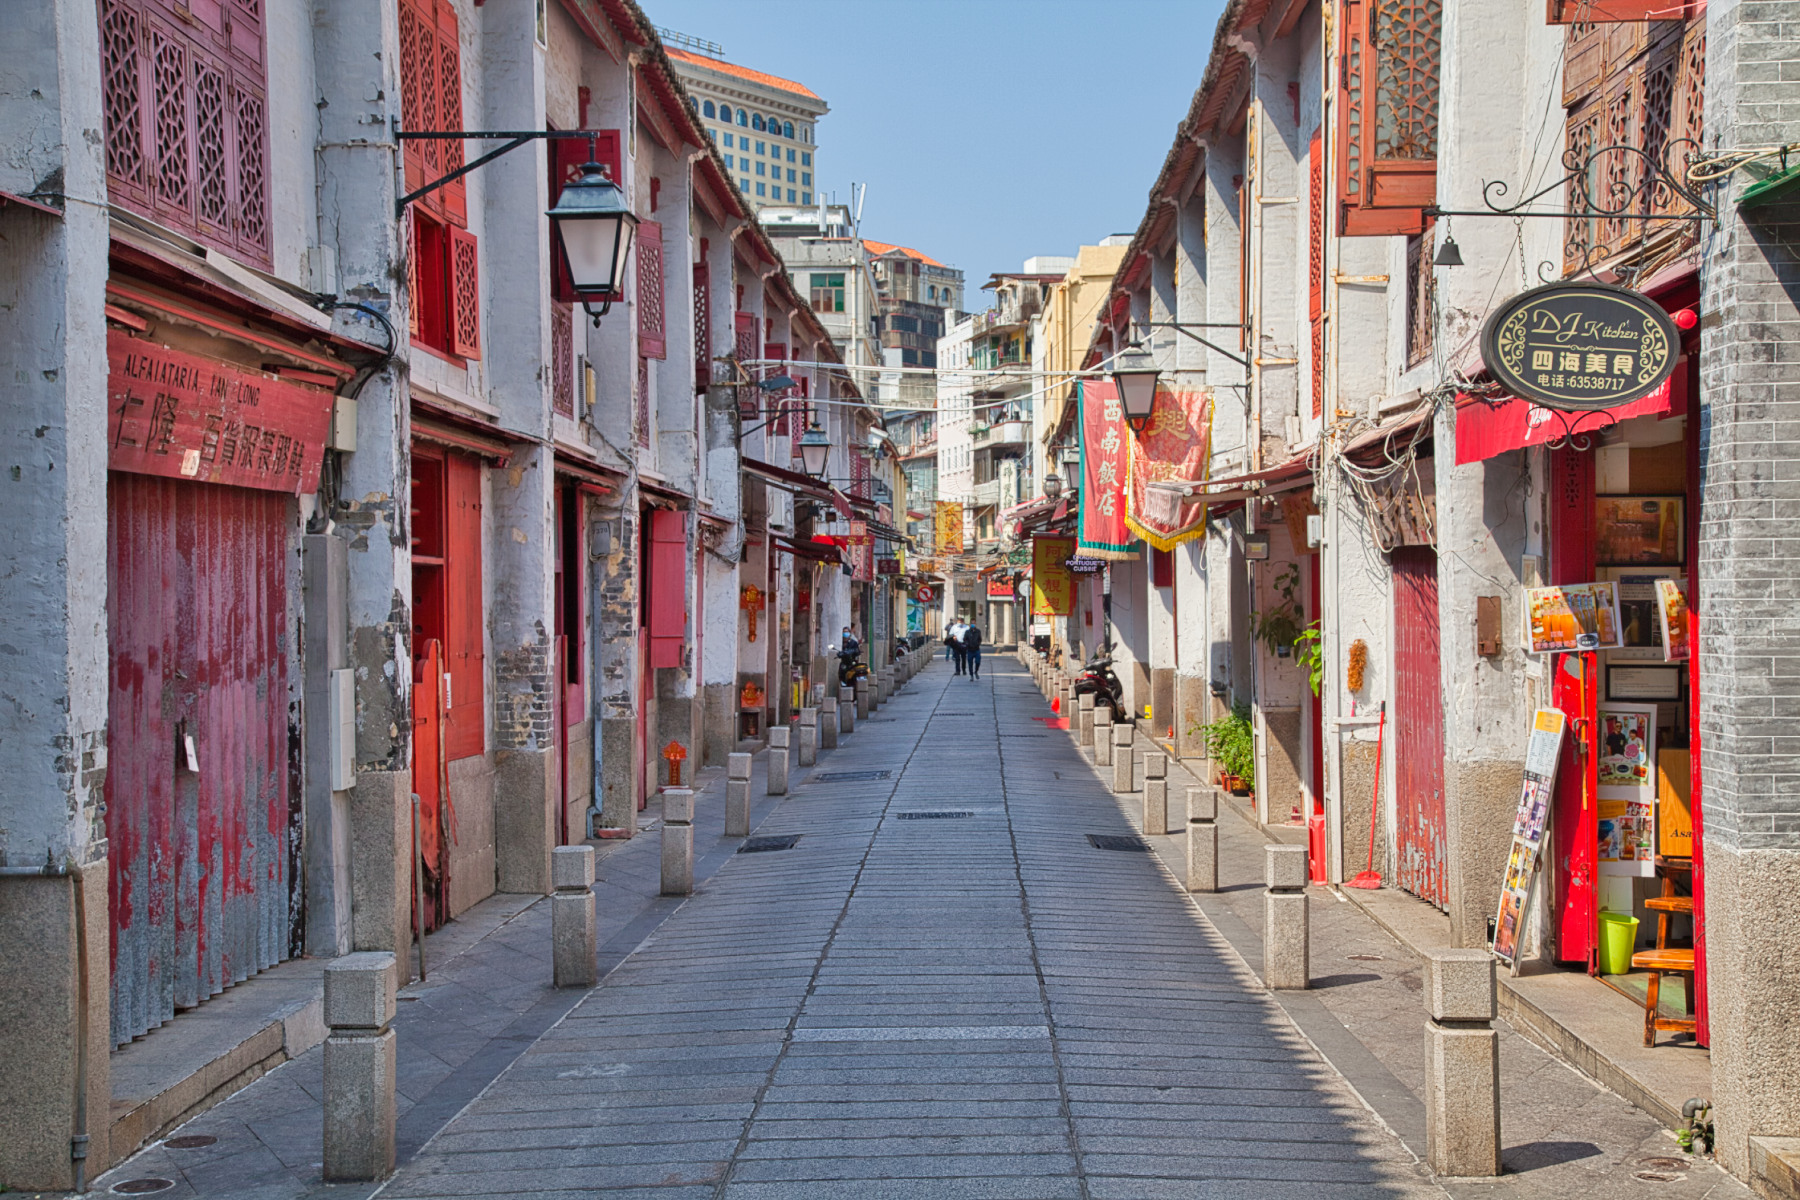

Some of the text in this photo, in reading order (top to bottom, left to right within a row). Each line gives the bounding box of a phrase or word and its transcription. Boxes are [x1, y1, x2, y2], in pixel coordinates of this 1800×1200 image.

[1531, 308, 1639, 343] DJ Kitchen
[123, 353, 199, 393] ALFAIATARIA
[237, 382, 261, 407] LONG
[1531, 350, 1635, 376] 四海美食
[1537, 374, 1626, 391] 电话:63538717
[1097, 398, 1123, 518] 西南飯店
